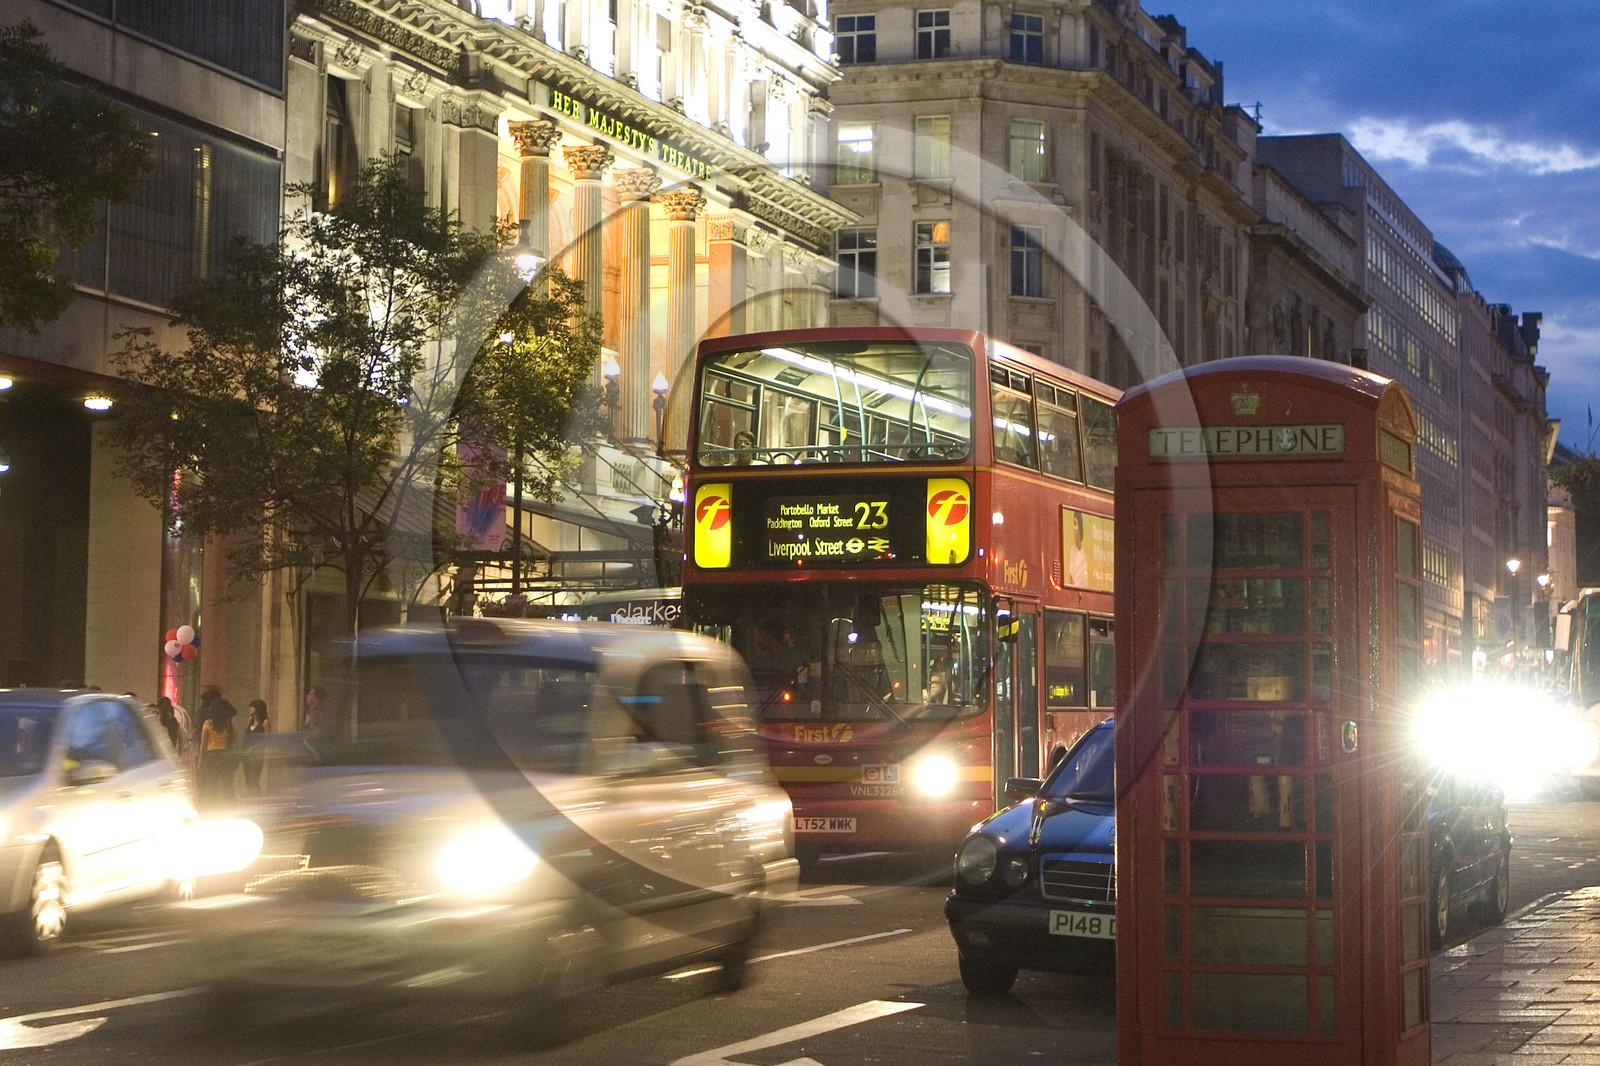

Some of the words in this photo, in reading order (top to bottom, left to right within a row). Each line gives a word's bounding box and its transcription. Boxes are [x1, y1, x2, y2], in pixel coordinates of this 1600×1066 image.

[553, 91, 580, 118] HER
[589, 108, 655, 154] MAJESTY'S
[662, 143, 712, 182] THEATRE
[1156, 427, 1337, 454] TELEPHONE
[780, 504, 814, 515] Portobello
[816, 503, 840, 515] Market
[854, 501, 889, 530] 23
[767, 517, 803, 531] Paddington
[809, 516, 831, 528] Oxford
[833, 515, 853, 527] Street
[768, 538, 812, 560] Liverpool
[815, 537, 845, 556] Street
[794, 725, 830, 742] First
[850, 785, 905, 796] VNL32264
[795, 818, 826, 830] LT52
[829, 818, 852, 830] WWK
[1056, 913, 1102, 935] P148
